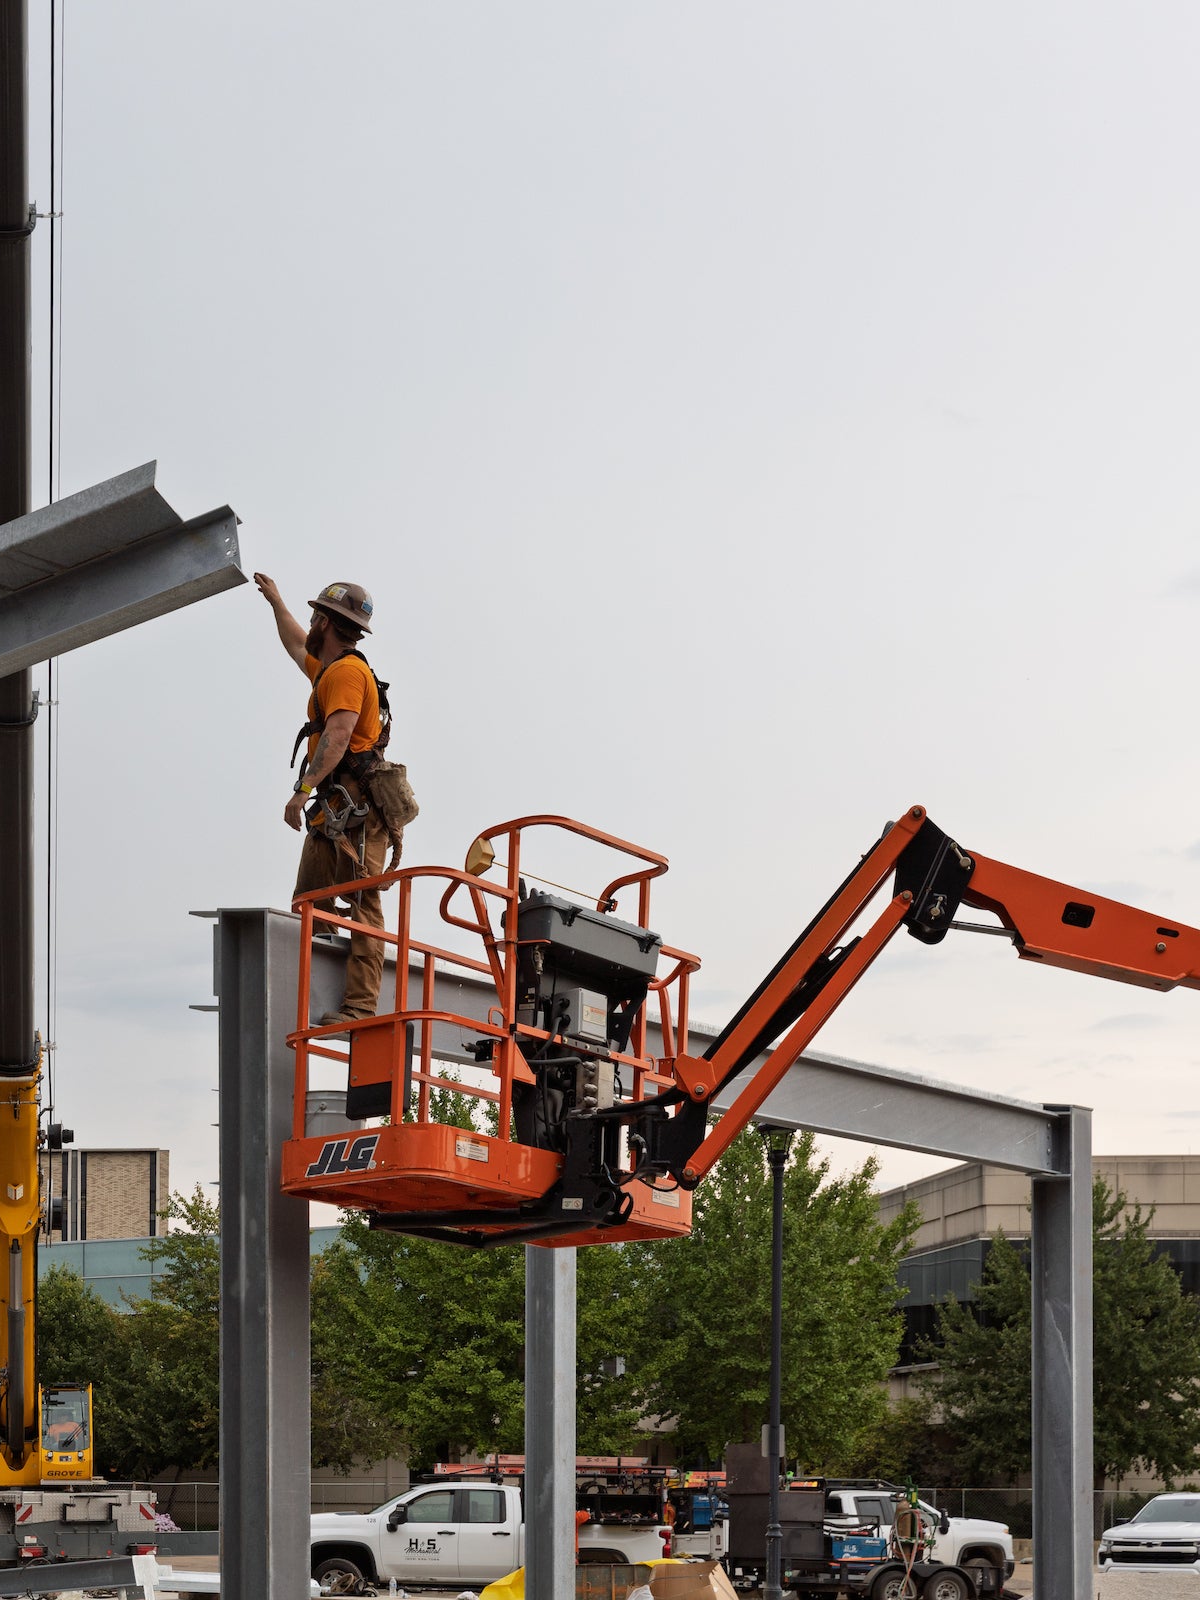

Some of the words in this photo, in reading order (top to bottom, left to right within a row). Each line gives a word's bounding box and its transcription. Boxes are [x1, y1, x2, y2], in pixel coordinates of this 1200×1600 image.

[305, 1134, 381, 1178] JLG
[409, 1538, 418, 1550] H
[427, 1538, 436, 1550] S
